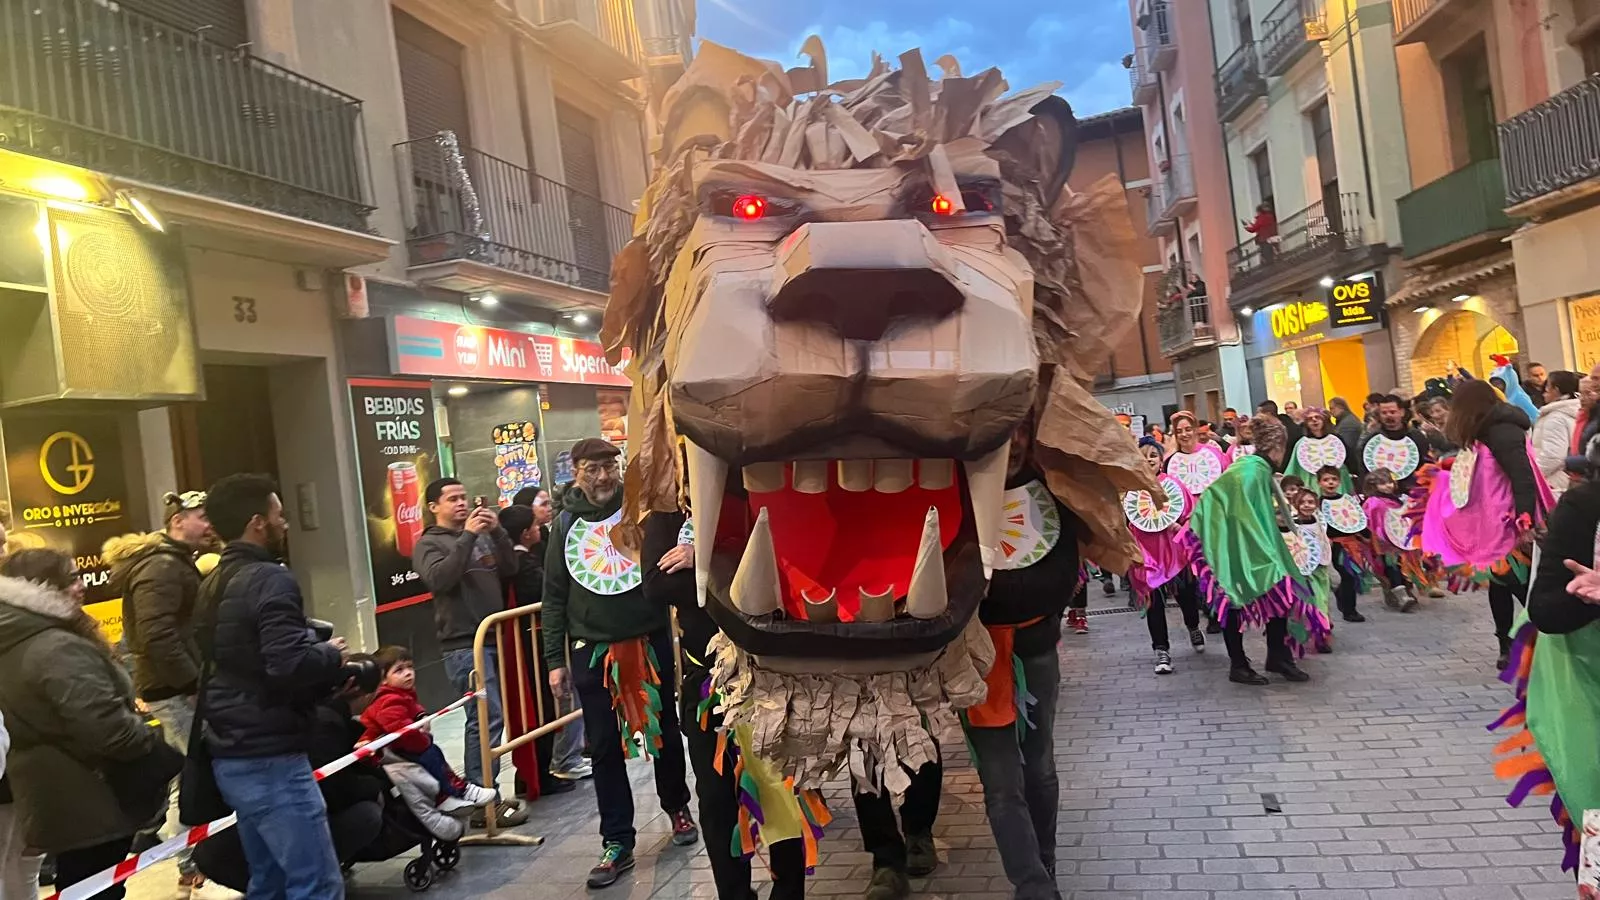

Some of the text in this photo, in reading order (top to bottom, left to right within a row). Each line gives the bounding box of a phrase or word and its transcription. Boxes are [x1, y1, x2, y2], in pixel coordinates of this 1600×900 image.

[1333, 282, 1370, 300] OVS
[232, 295, 257, 324] 33
[1342, 305, 1365, 317] kids
[1272, 303, 1299, 338] OVS
[488, 335, 526, 368] Mini
[364, 396, 425, 415] BEBIDAS
[375, 415, 421, 441] FRÍAS
[23, 507, 52, 521] ORO
[55, 516, 94, 528] GRUPO
[390, 573, 404, 586] 365
